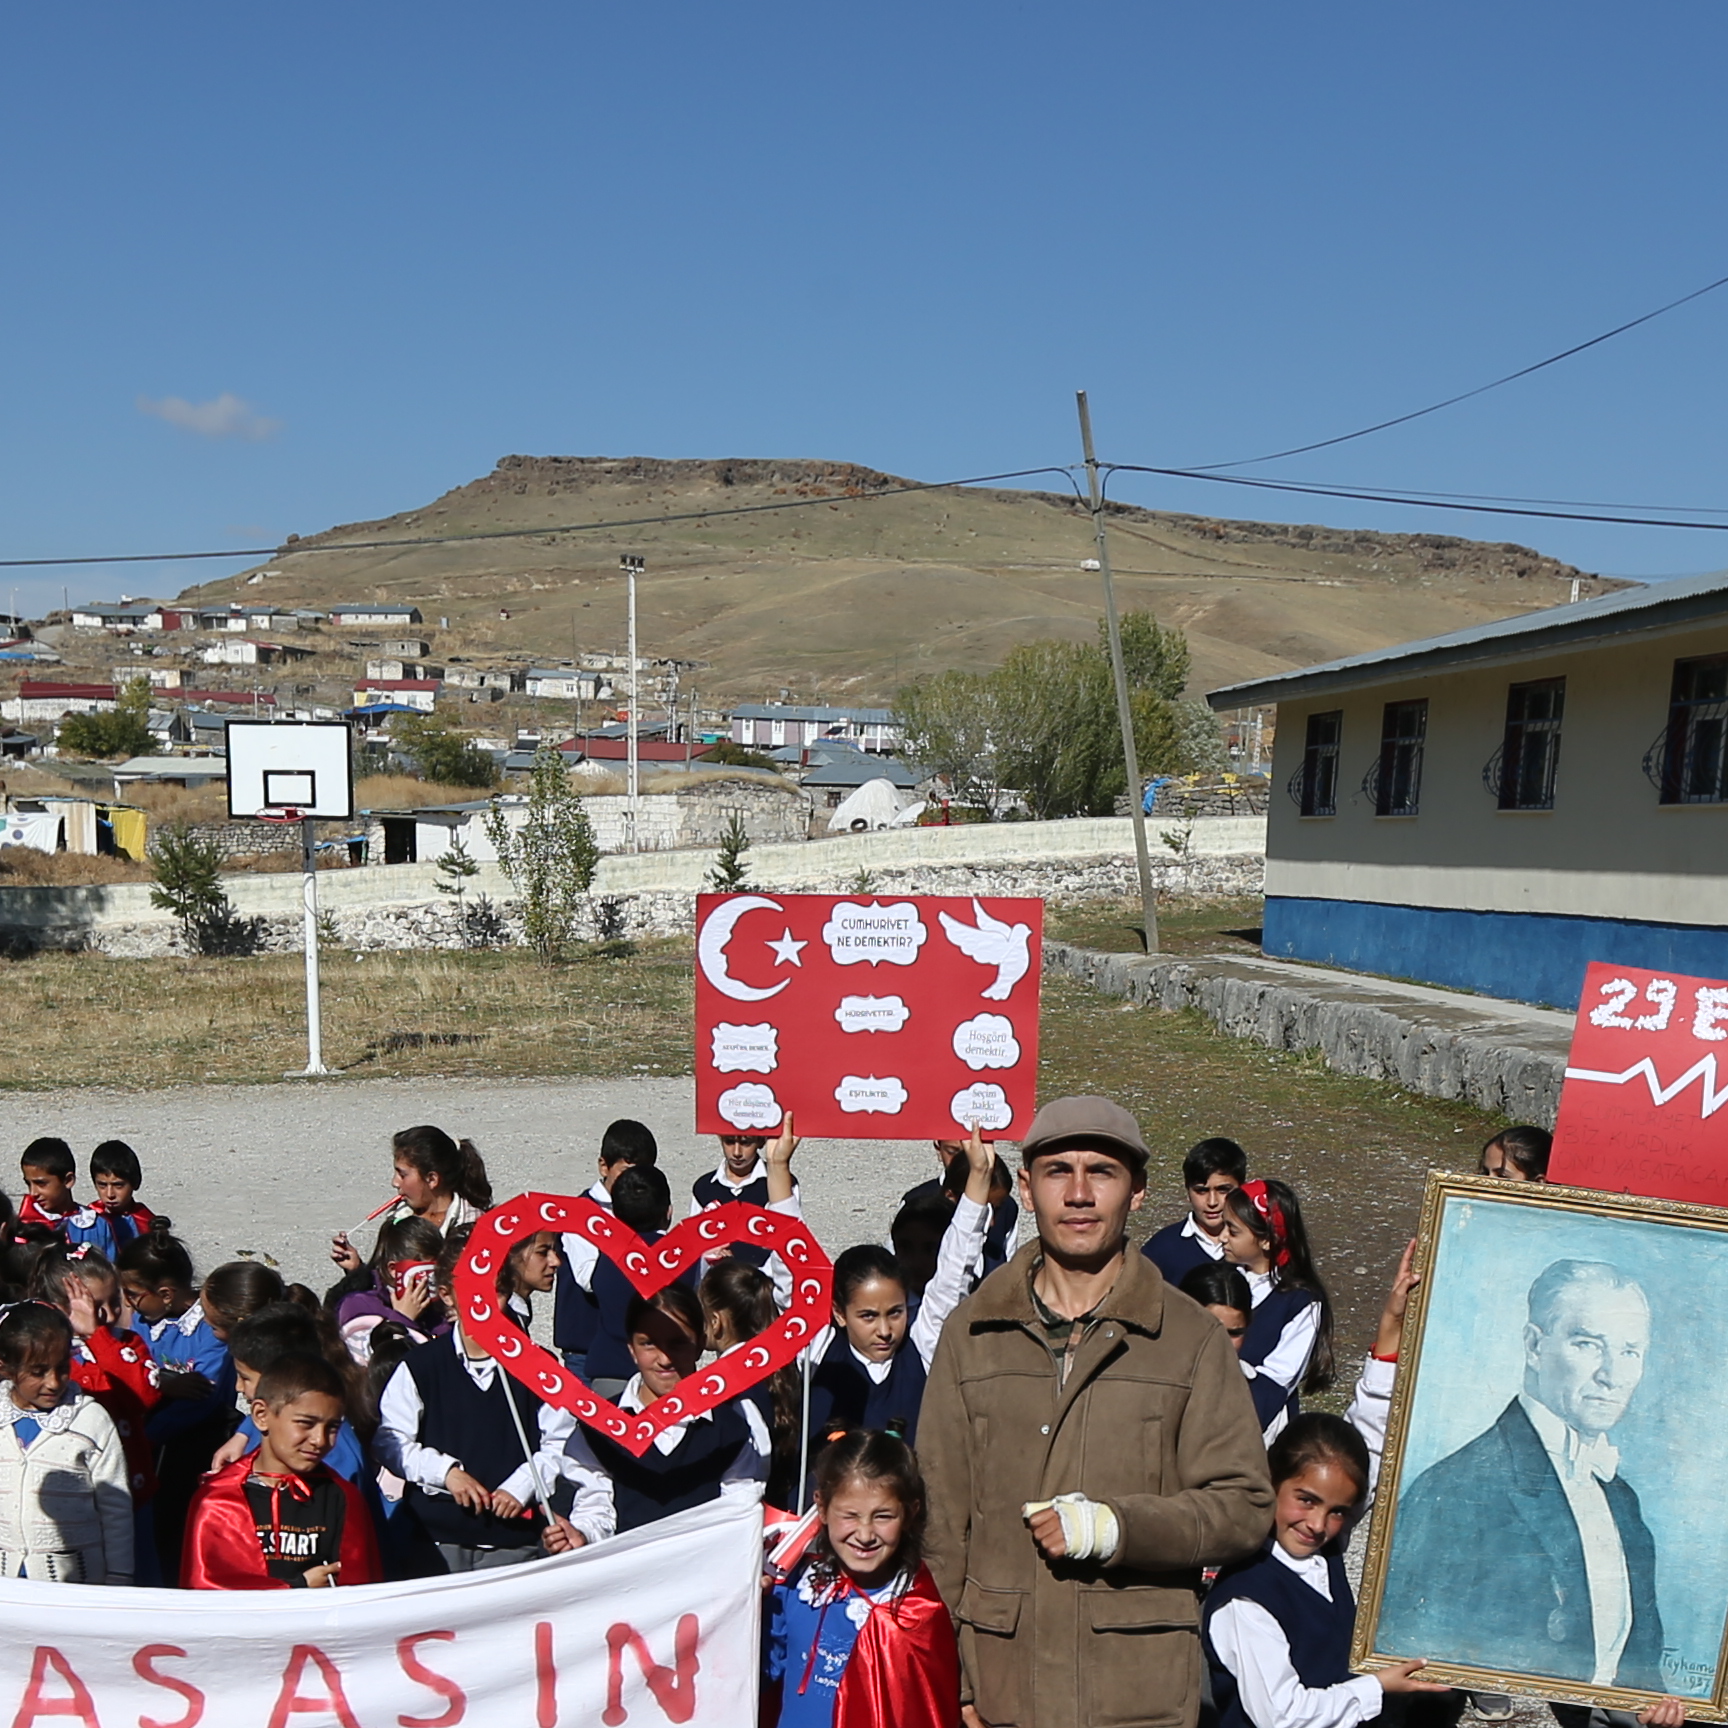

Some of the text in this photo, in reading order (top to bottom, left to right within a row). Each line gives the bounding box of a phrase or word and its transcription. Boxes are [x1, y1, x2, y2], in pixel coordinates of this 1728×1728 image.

[841, 916, 909, 930] CUMHURİYET
[836, 934, 913, 948] NE DEMEKTİR?
[1589, 978, 1678, 1032] 29
[969, 1030, 1007, 1044] Hoşgörü
[965, 1043, 1008, 1058] demektir.
[972, 1088, 997, 1100] Seçim
